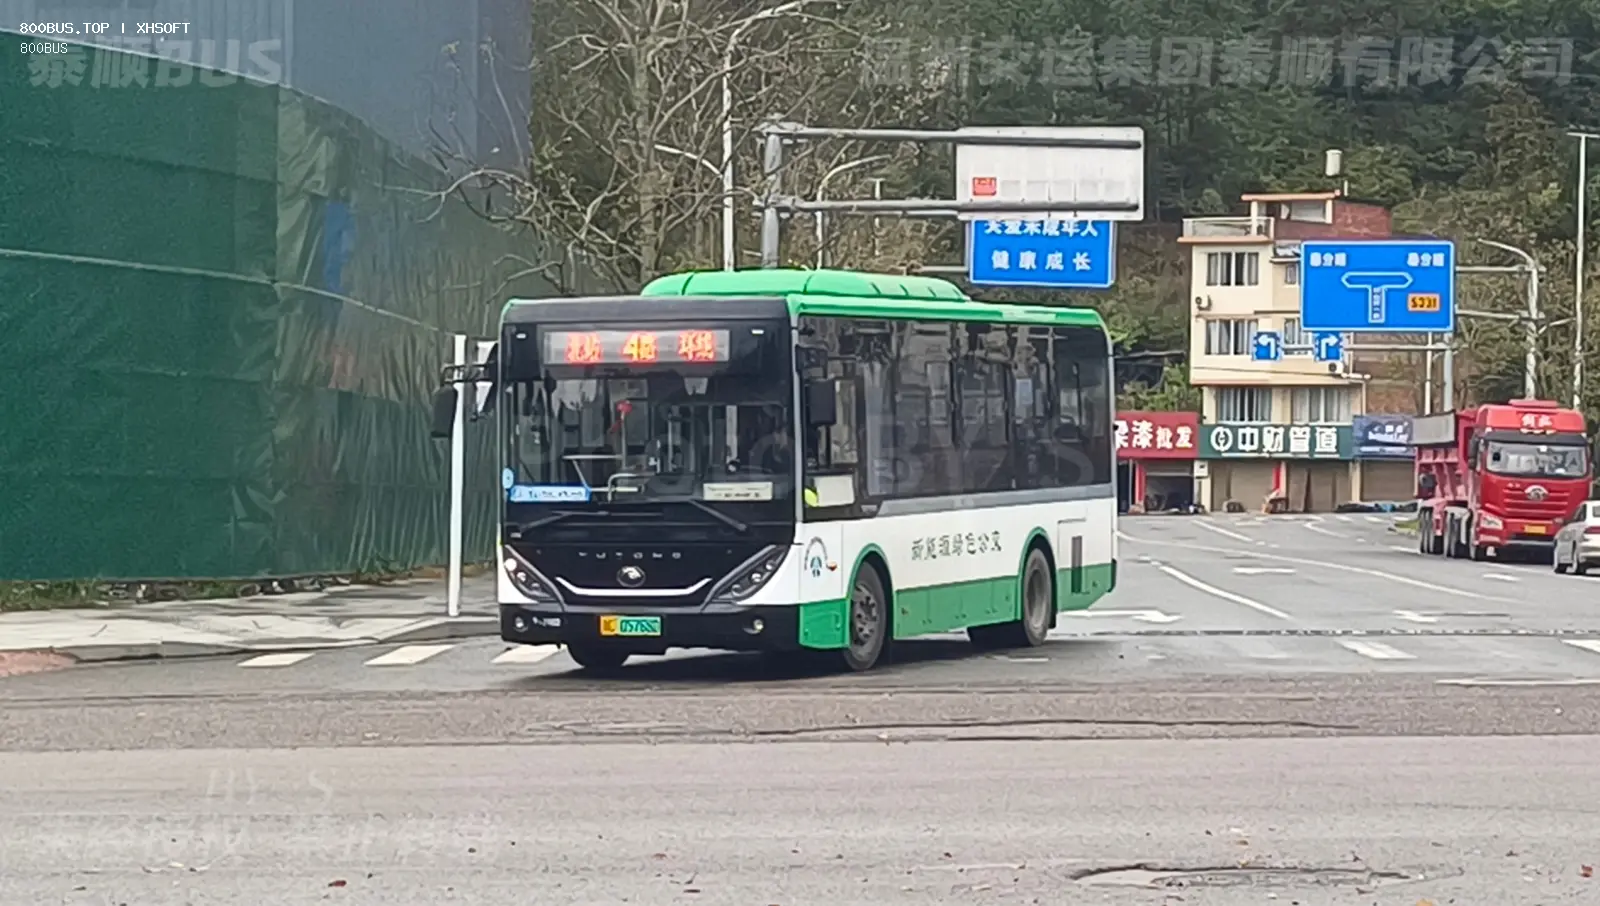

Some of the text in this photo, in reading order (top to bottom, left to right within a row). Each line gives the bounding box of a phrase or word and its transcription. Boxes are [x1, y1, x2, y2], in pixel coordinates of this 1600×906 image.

[991, 250, 1092, 271] 健康成长
[1237, 426, 1338, 453] 中财管道
